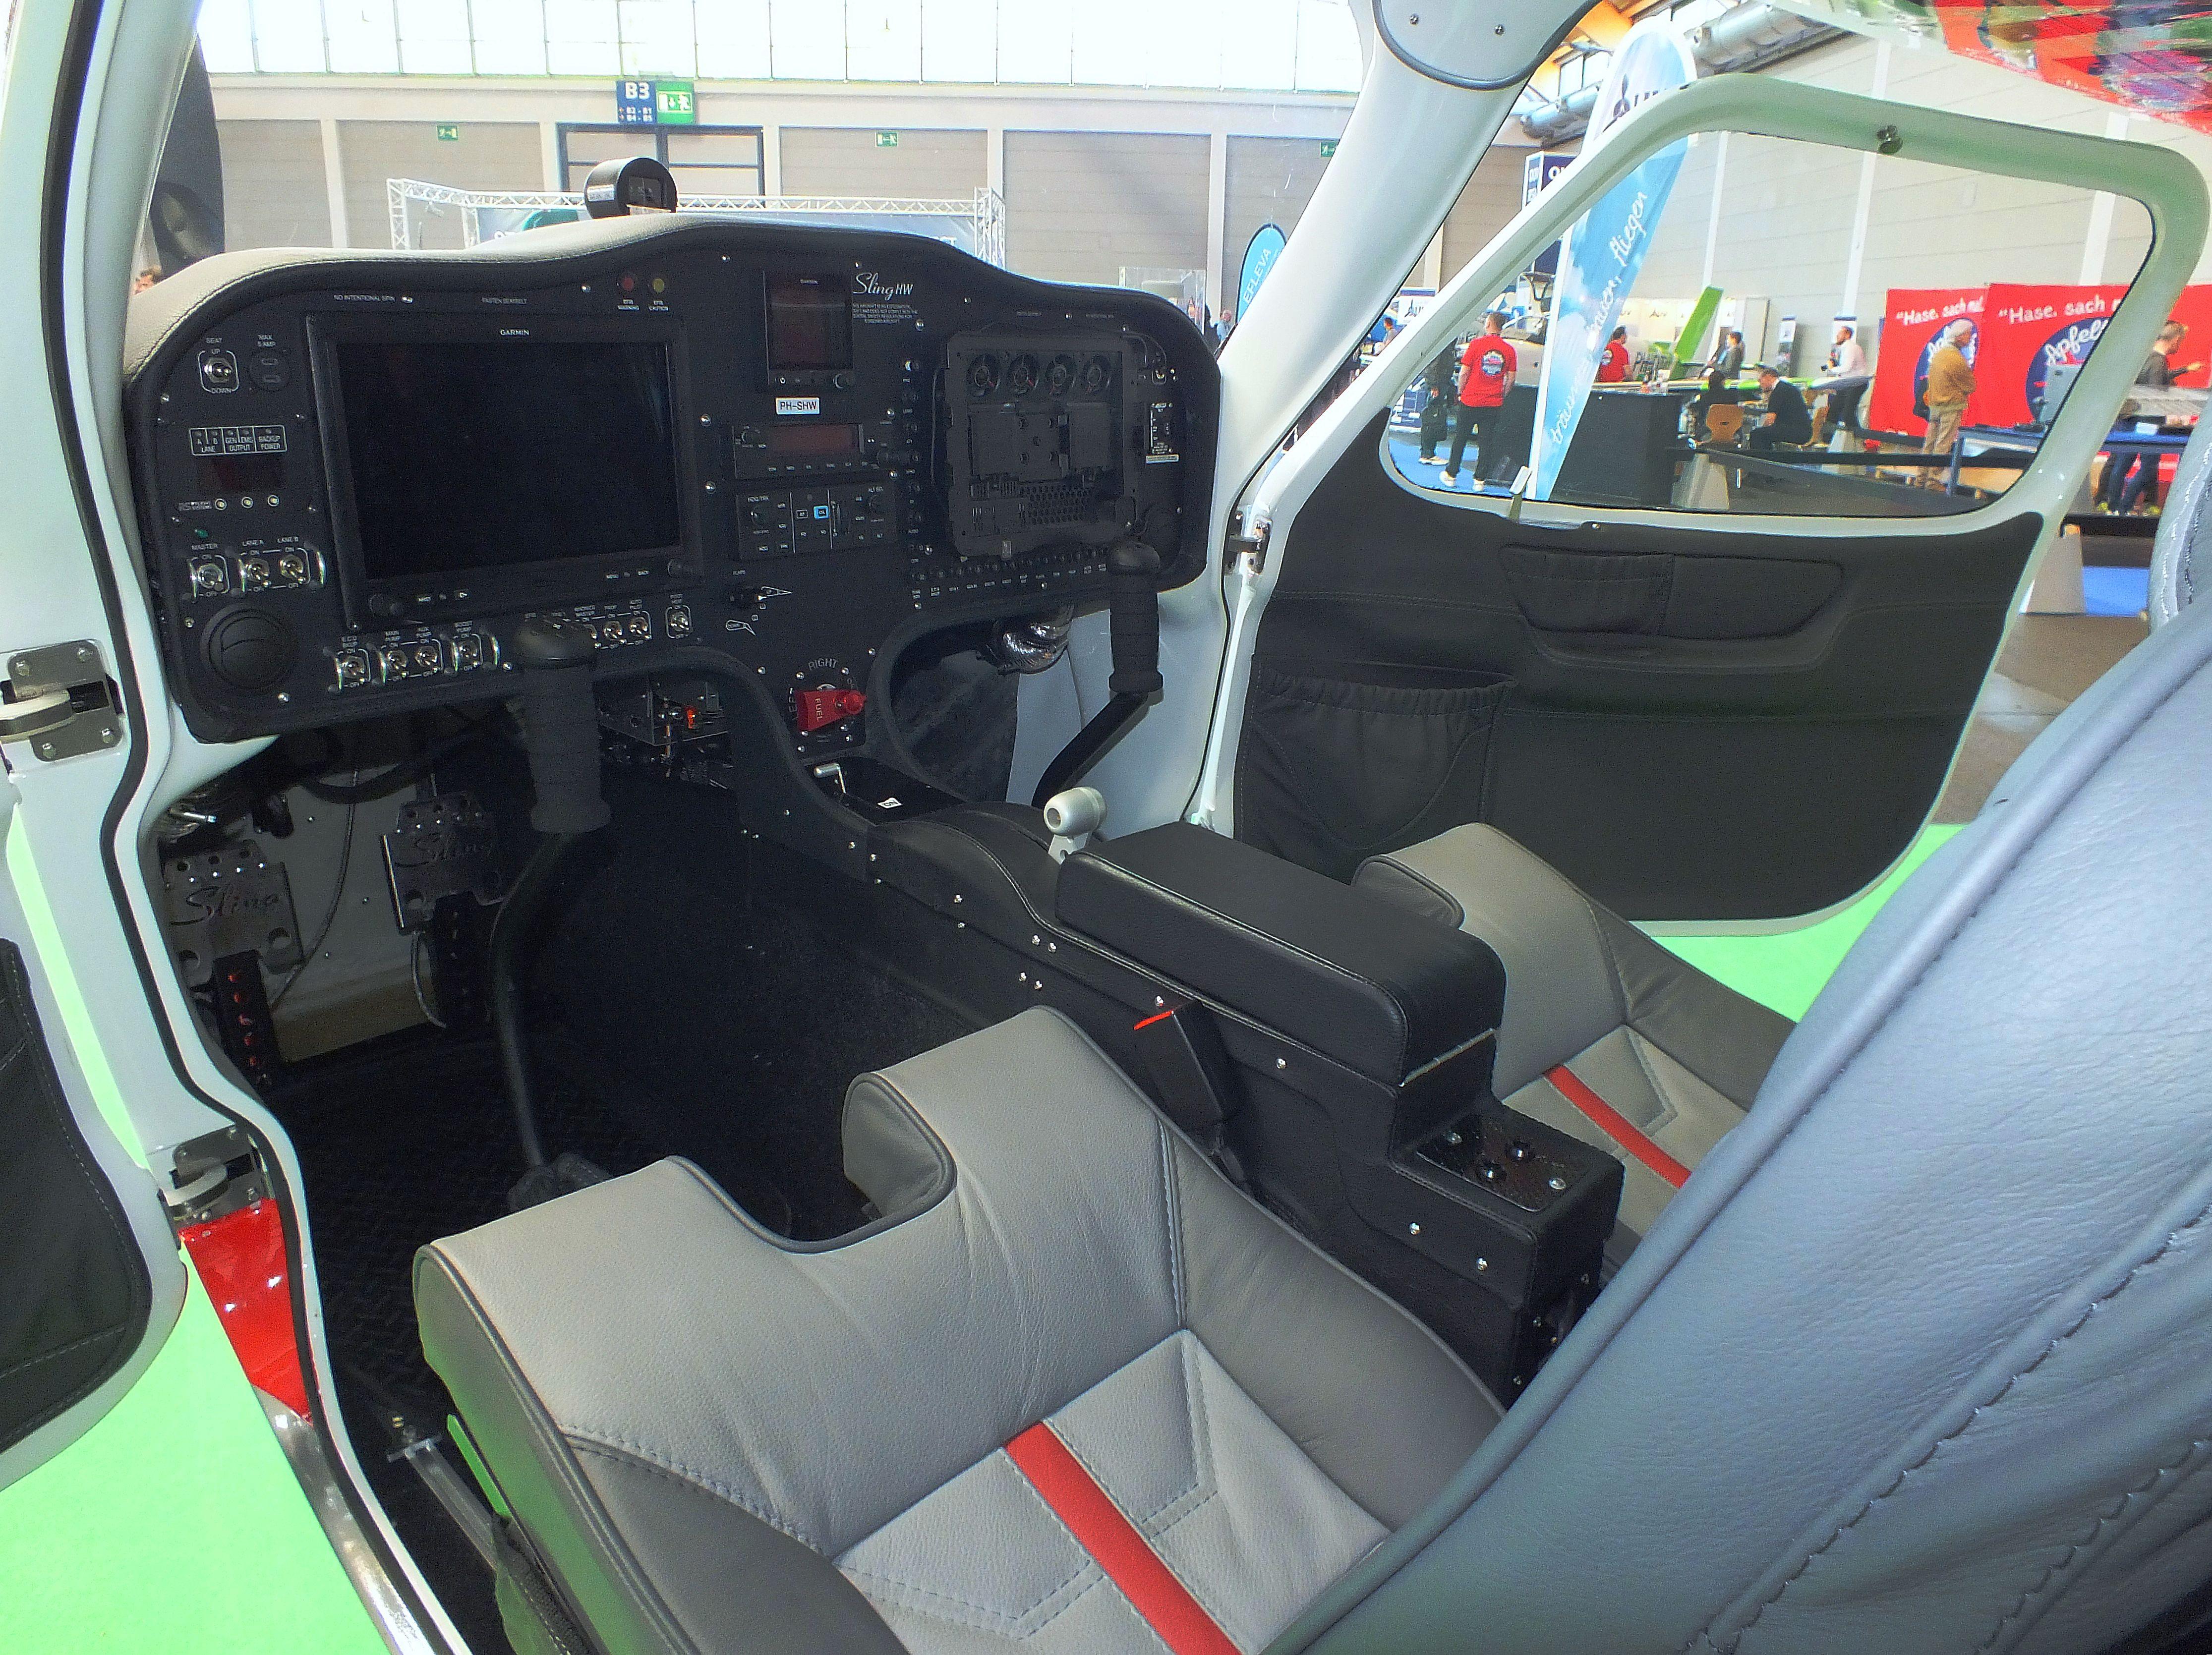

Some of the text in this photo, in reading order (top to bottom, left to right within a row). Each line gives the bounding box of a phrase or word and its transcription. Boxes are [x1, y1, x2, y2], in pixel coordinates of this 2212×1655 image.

[625, 82, 649, 99] B3
[1609, 191, 1648, 267] fliegen
[853, 273, 914, 300] Sling HW
[1243, 248, 1272, 305] EFLEVA
[2064, 294, 2106, 316] sach
[780, 401, 817, 410] PH-SHW
[808, 658, 838, 670] RIGHT
[815, 697, 823, 722] FUEL
